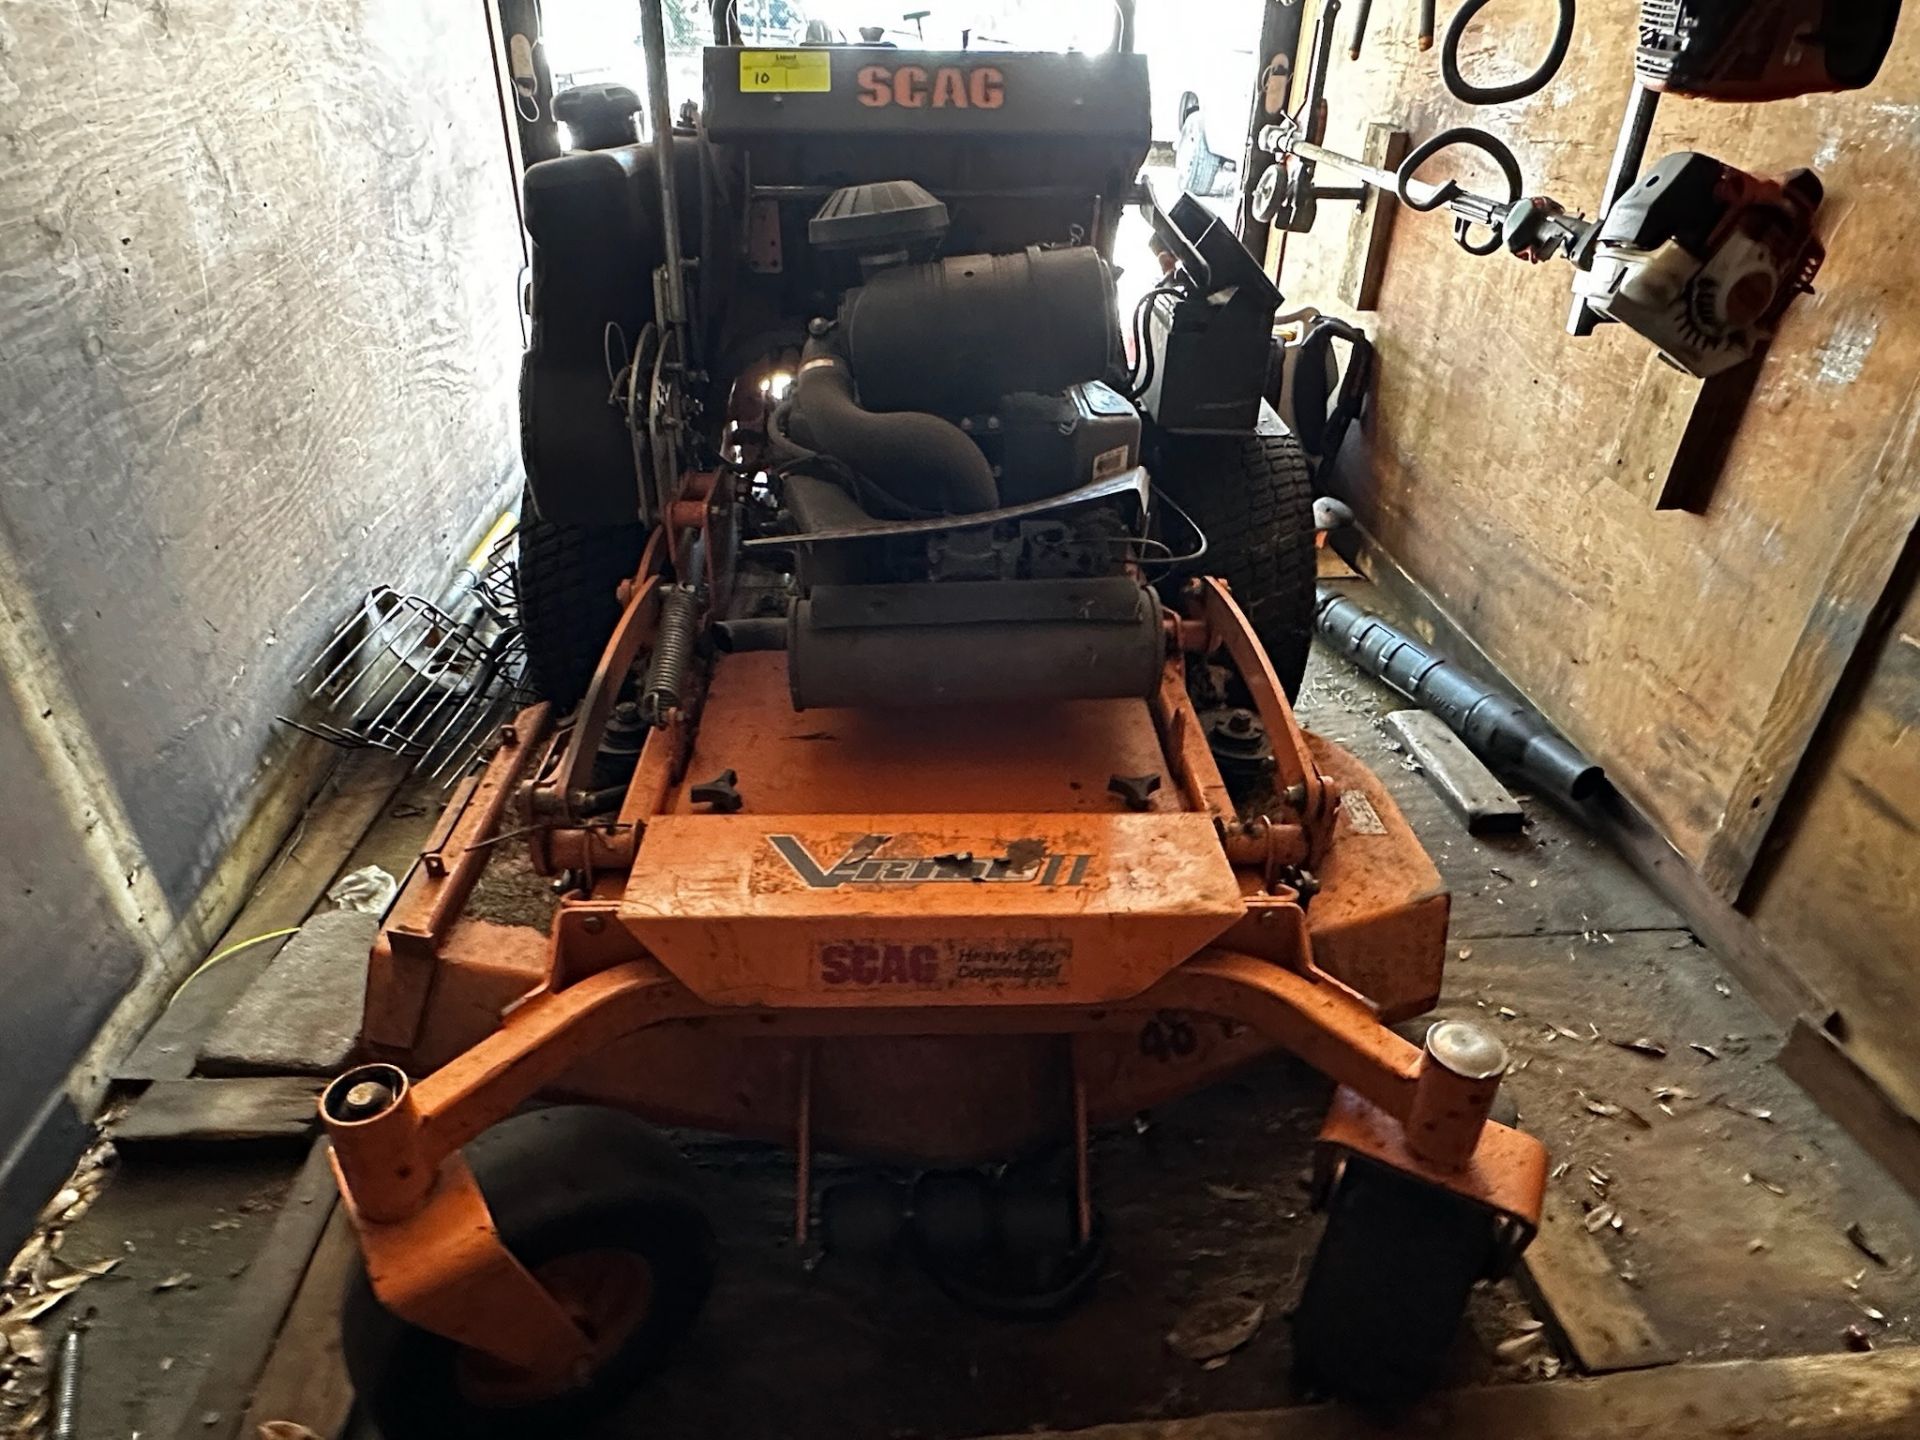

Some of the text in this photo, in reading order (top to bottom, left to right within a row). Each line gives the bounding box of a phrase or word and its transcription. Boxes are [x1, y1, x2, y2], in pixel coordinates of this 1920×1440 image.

[754, 71, 770, 85] 10
[857, 65, 1005, 109] SCAG
[820, 944, 938, 985] SCAG
